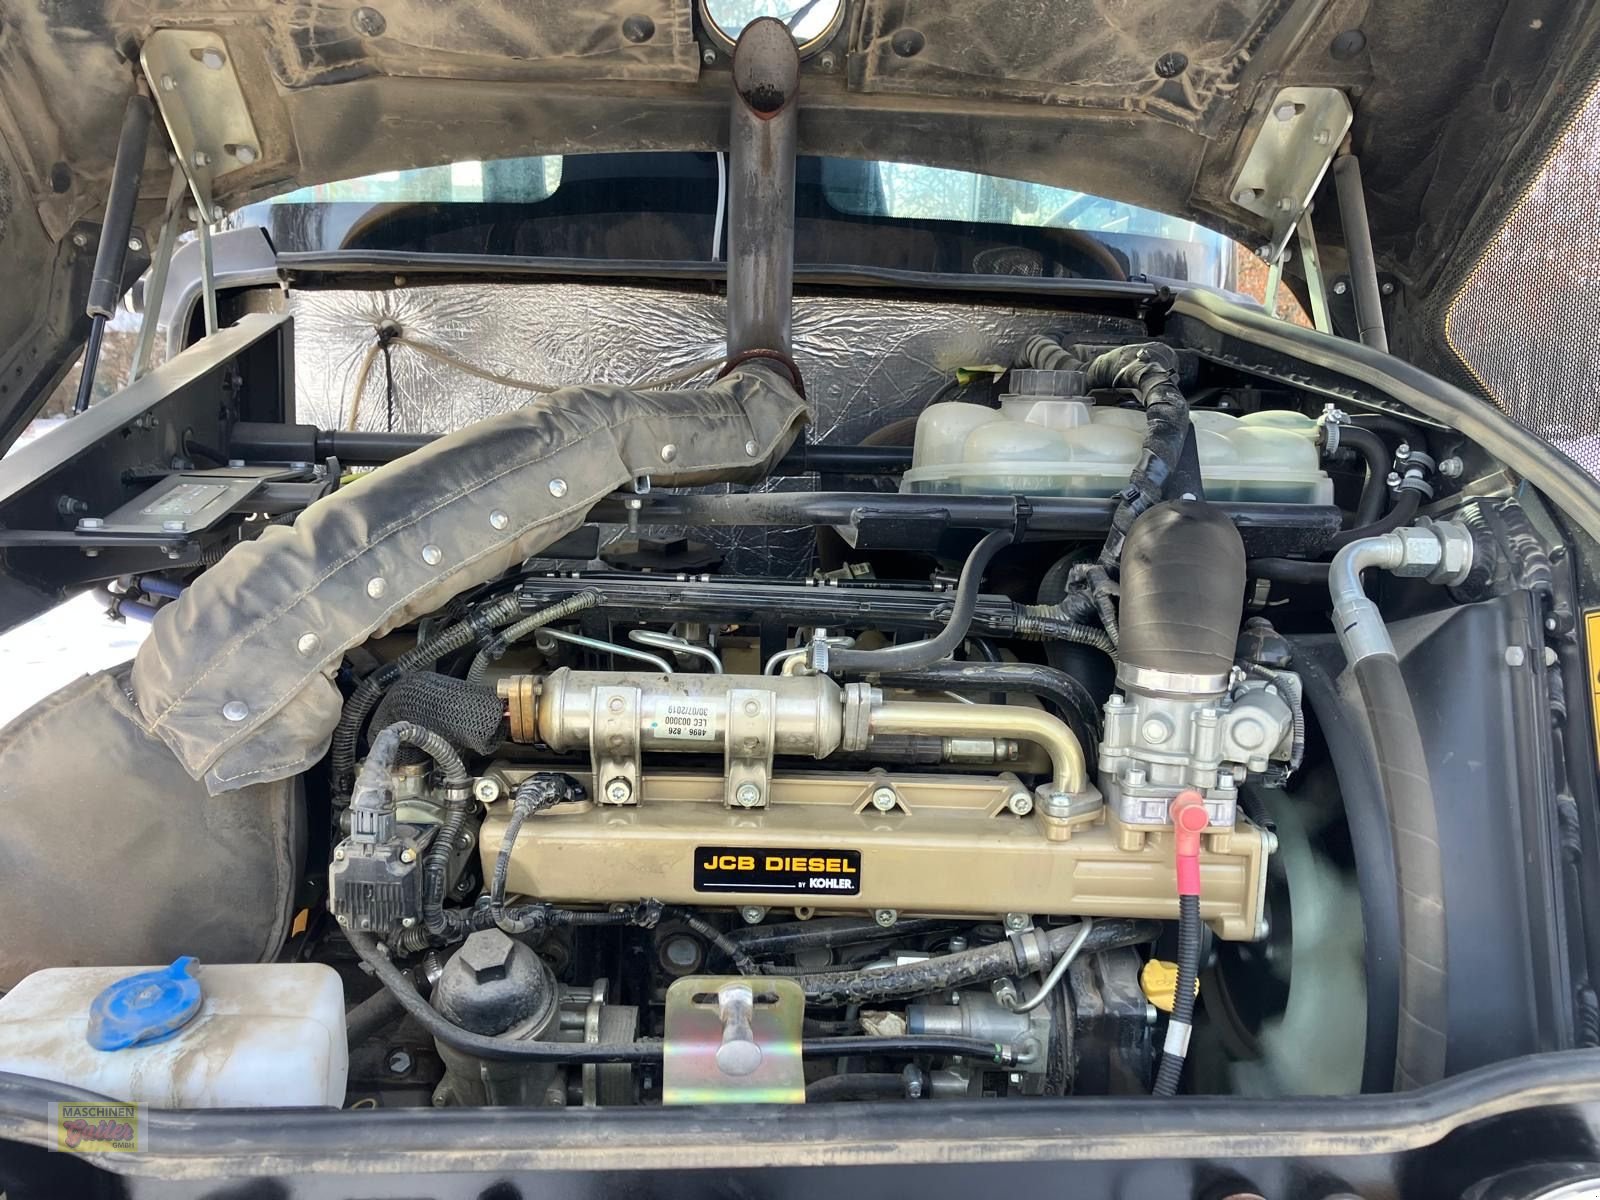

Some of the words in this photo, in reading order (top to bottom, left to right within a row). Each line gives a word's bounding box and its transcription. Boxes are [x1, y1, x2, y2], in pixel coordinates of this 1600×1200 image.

[668, 705, 708, 716] 30/07/2019
[665, 716, 691, 726] 003000
[693, 718, 707, 727] LEC
[703, 855, 755, 871] JCB
[765, 857, 857, 873] DIESEL
[798, 881, 806, 889] BY
